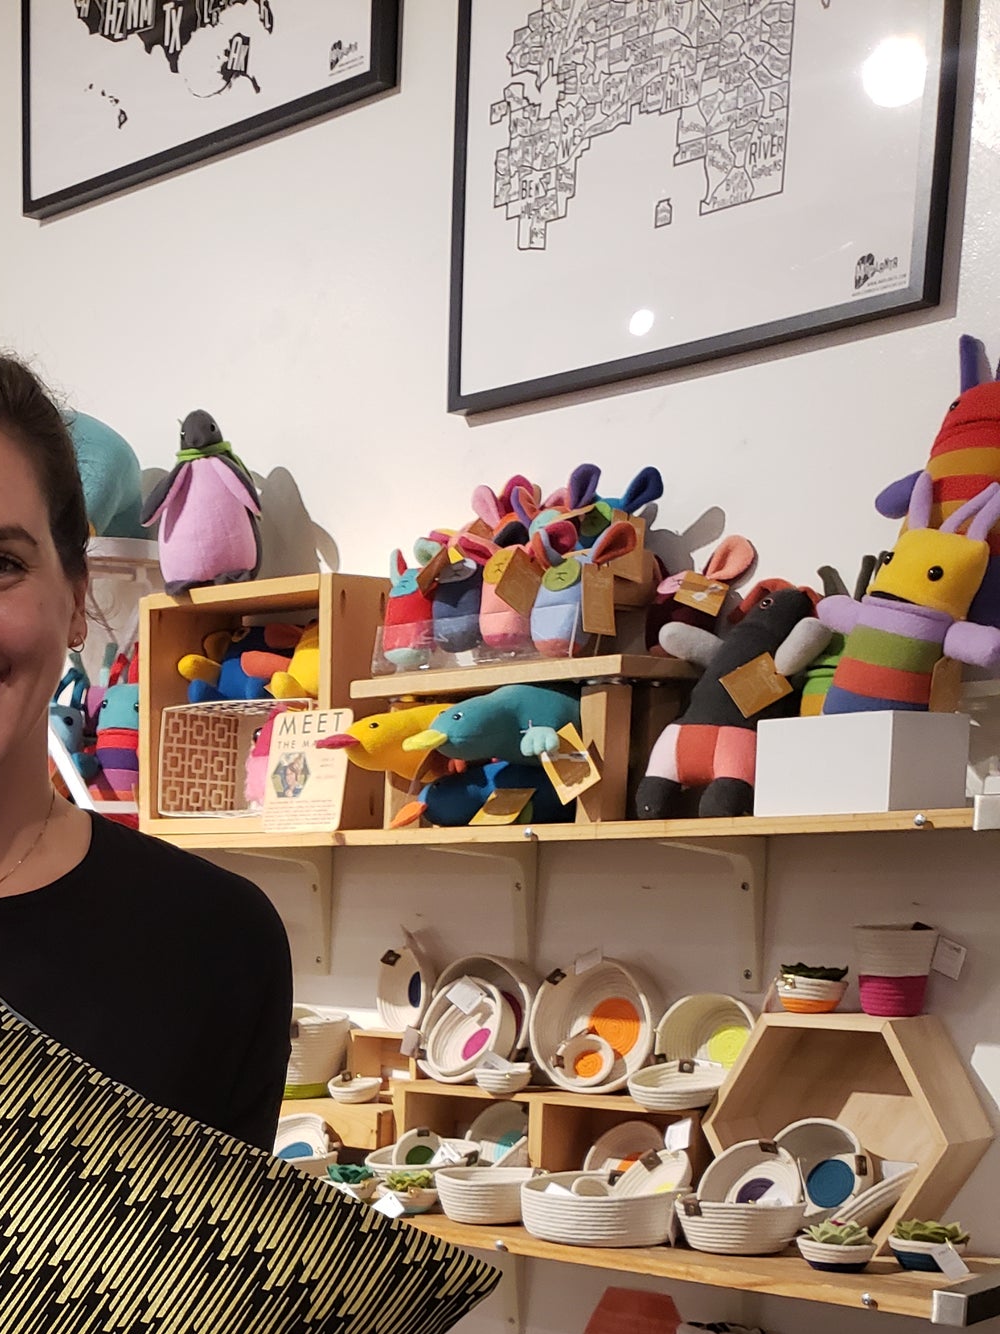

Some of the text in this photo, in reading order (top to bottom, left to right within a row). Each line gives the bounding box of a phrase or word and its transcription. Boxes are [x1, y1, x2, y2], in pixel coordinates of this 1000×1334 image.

[163, 2, 183, 53] TX
[227, 36, 249, 71] AK
[749, 134, 784, 165] RIVER
[279, 712, 343, 736] MEET
[278, 740, 296, 749] THE
